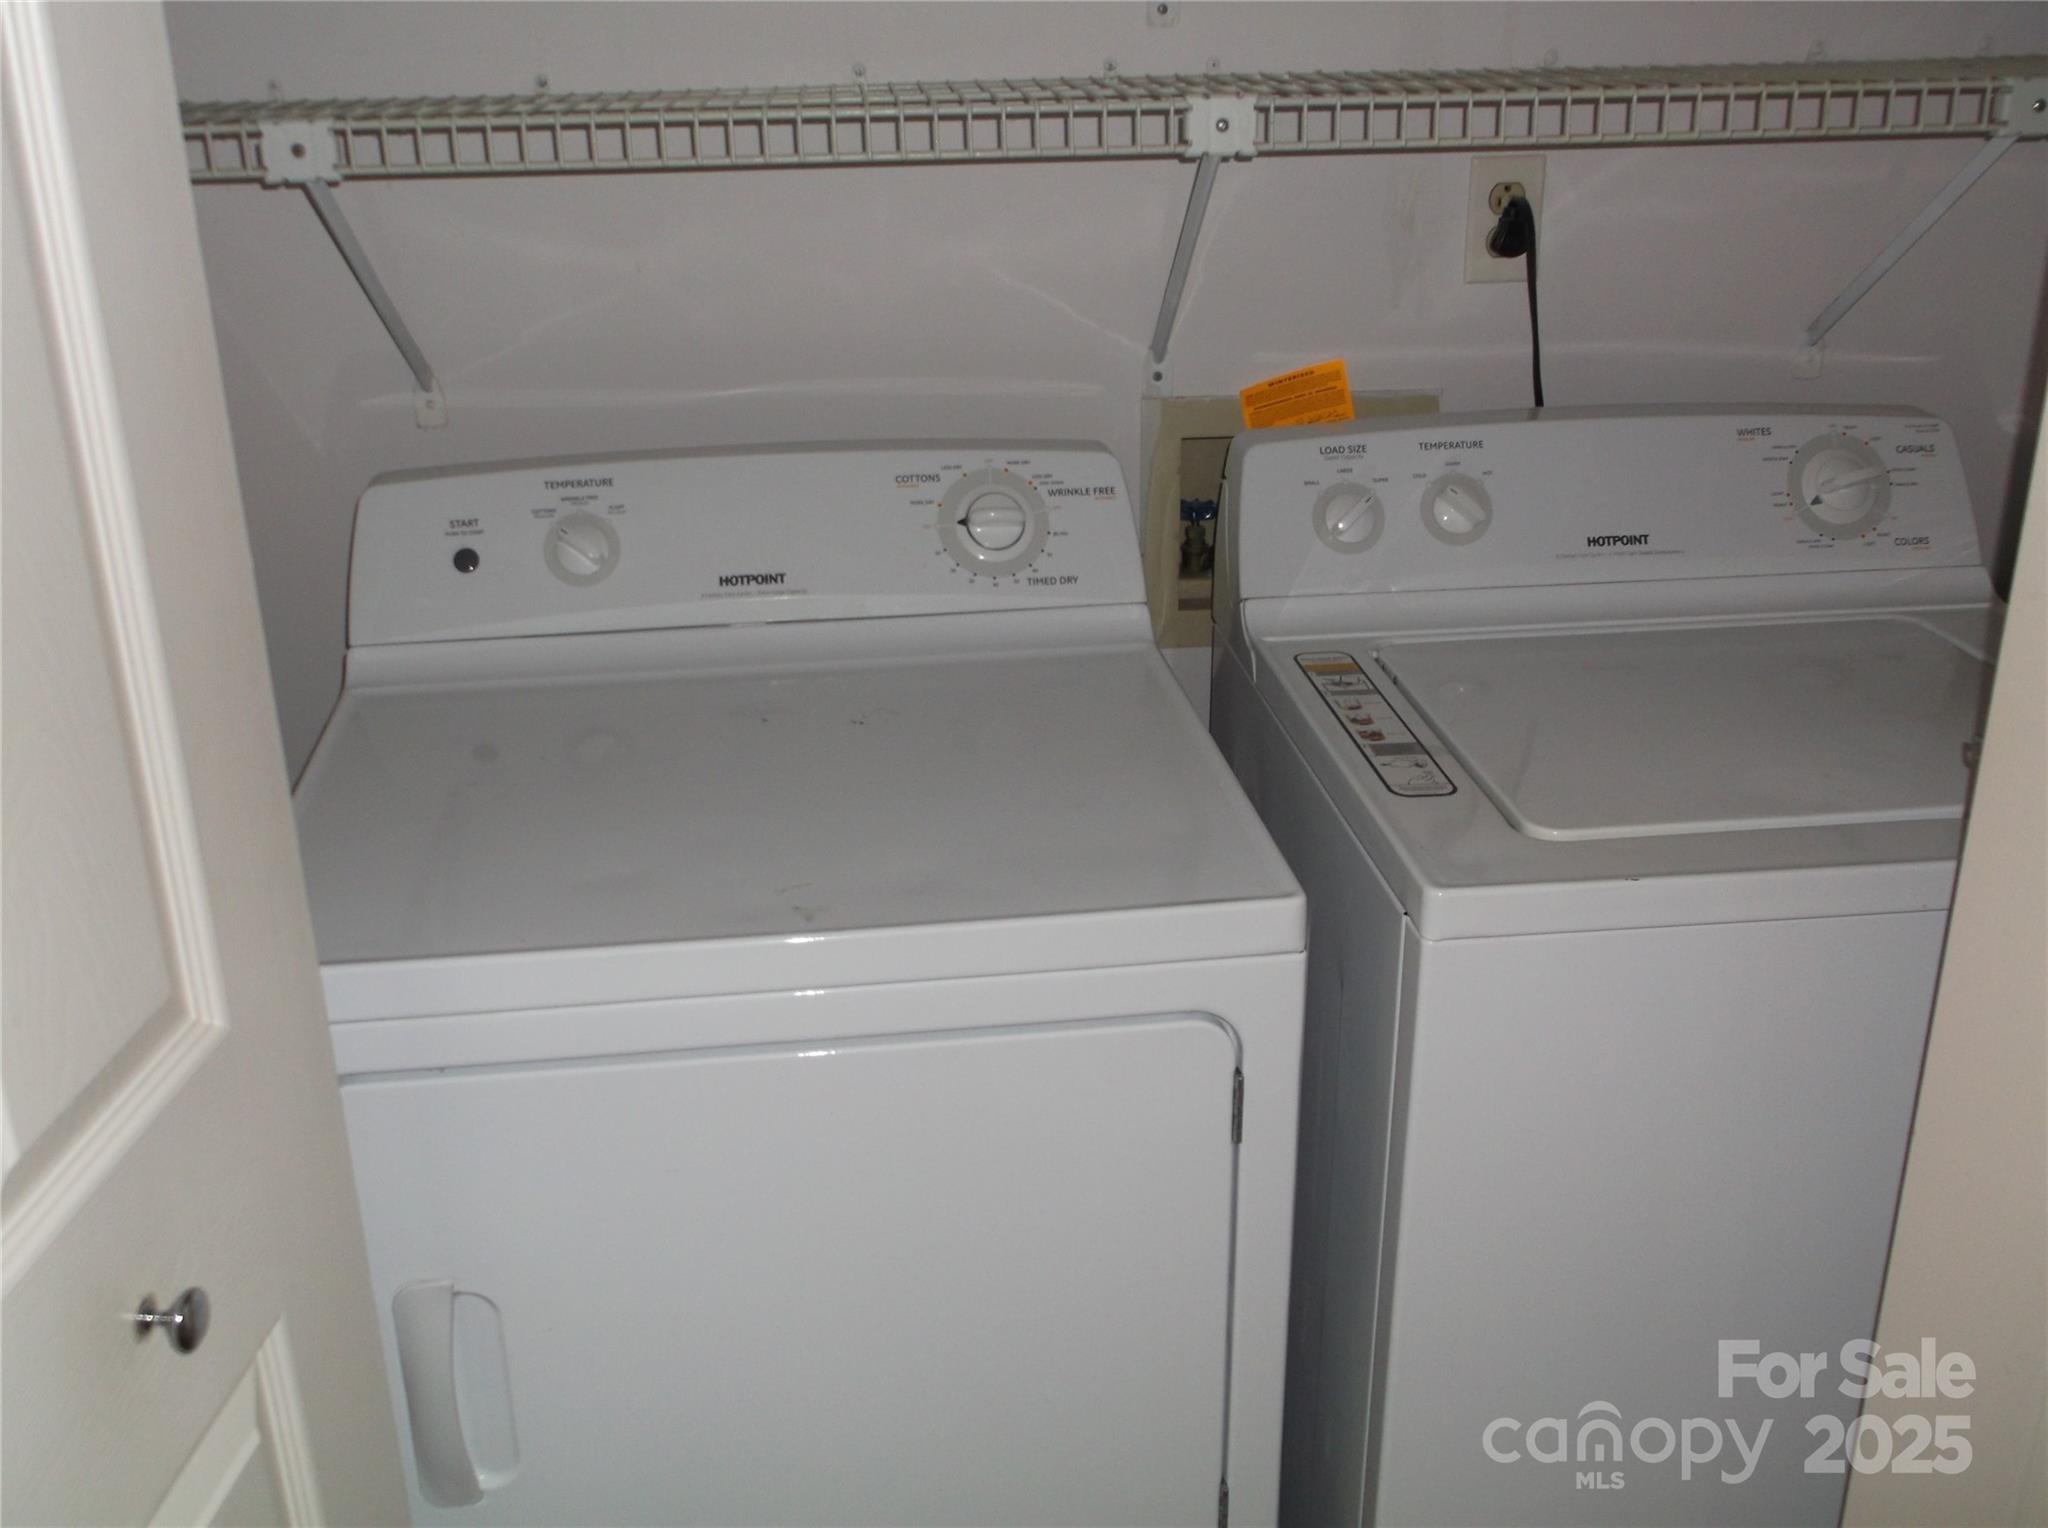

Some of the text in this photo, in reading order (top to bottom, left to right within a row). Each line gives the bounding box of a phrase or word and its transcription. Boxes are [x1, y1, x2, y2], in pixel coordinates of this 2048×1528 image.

[1736, 427, 1772, 437] WHITES
[1319, 444, 1368, 455] LOAD SIZE
[1419, 440, 1484, 451] TEMPERATURE
[1895, 444, 1935, 454] CASUALS
[544, 477, 614, 490] TEMPERATURE
[895, 473, 941, 484] COTTONS
[1047, 486, 1116, 497] WRINKLE FREE
[449, 518, 479, 529] START
[1587, 534, 1649, 547] HOTPOINT
[1894, 536, 1930, 546] COLORS
[719, 573, 786, 587] HOTPOINT
[1027, 577, 1058, 586] TIMED
[1059, 575, 1079, 585] DRY
